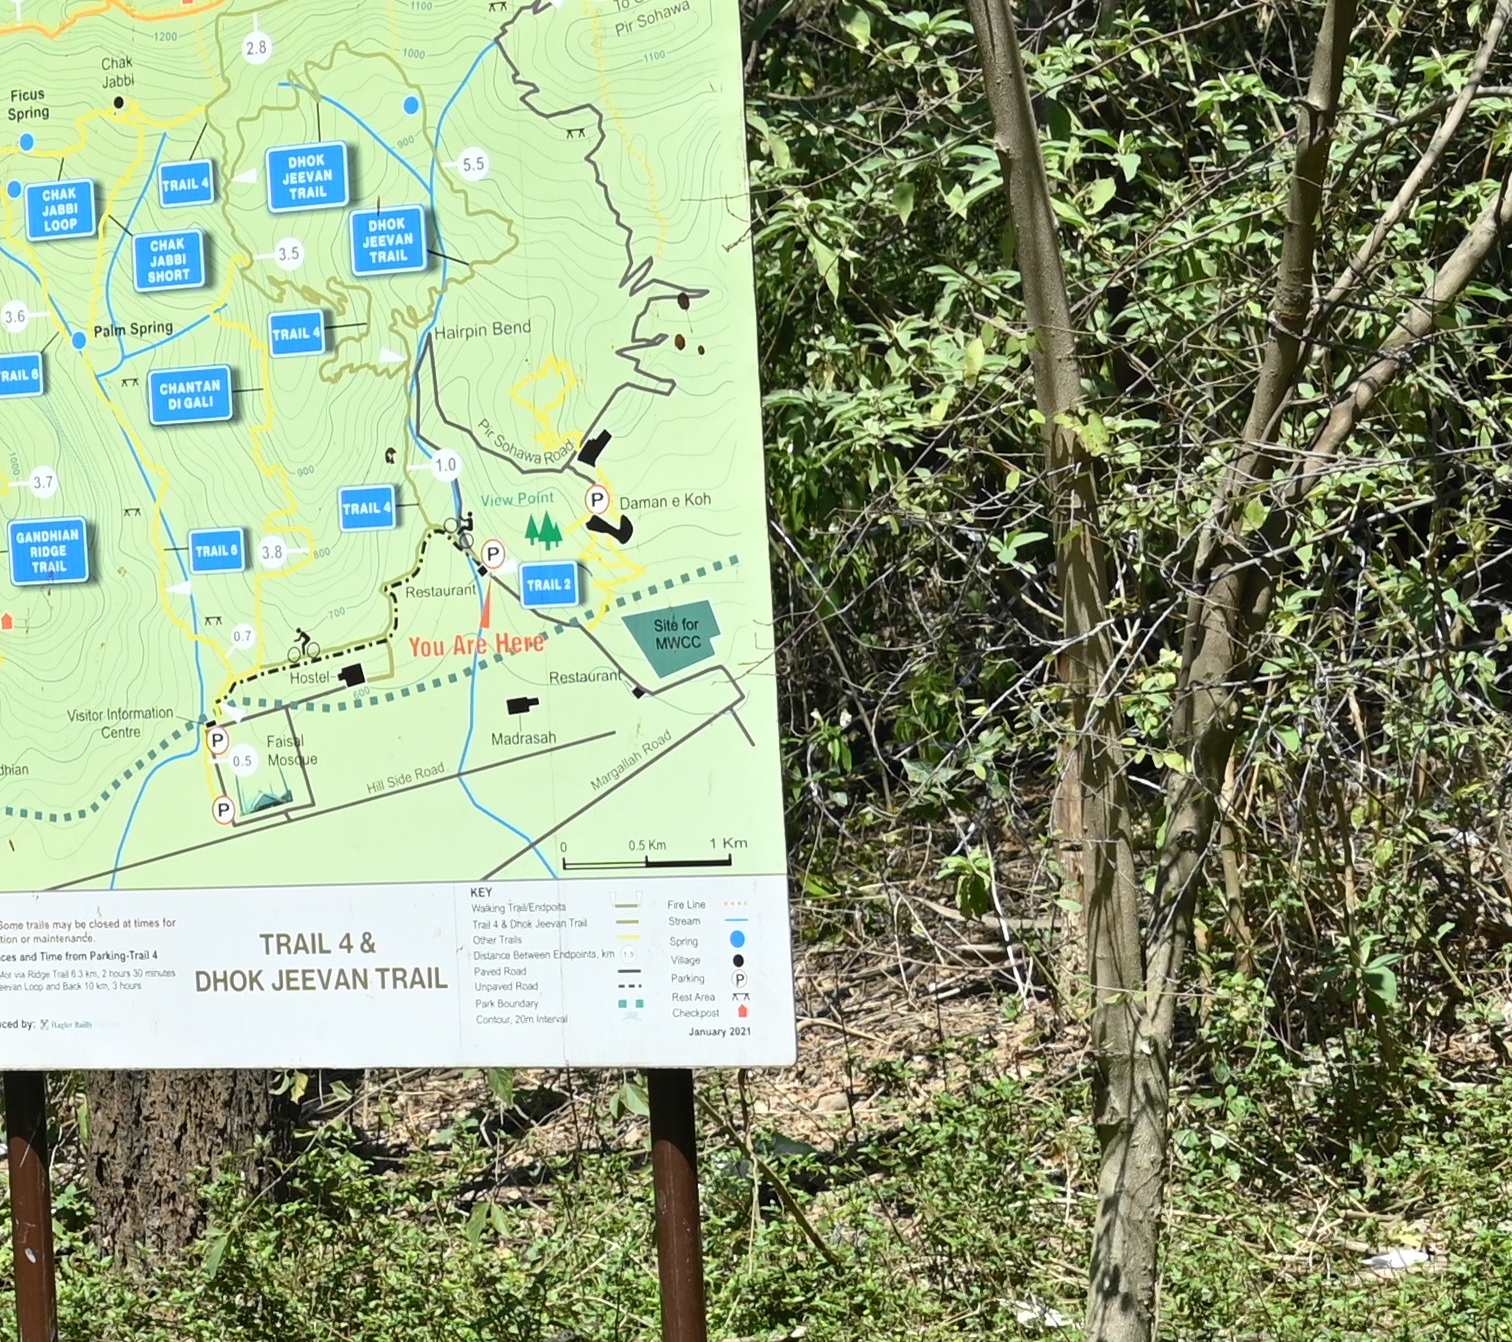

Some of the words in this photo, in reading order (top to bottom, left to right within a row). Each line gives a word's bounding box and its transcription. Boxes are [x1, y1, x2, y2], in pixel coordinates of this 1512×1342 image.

[616, 20, 634, 37] Pir
[637, 0, 690, 26] Sohawa
[247, 41, 267, 55] 2.8
[102, 56, 132, 71] Chak
[102, 72, 134, 89] Jabbi
[11, 89, 45, 102] Ficus
[8, 107, 49, 121] Spring
[288, 154, 324, 169] DHOK
[463, 157, 484, 171] 5.5
[283, 169, 332, 185] JEEVAN
[163, 179, 198, 192] TRAIL
[201, 178, 208, 188] 4
[42, 188, 76, 201] CHAK
[289, 186, 327, 200] TRAIL
[42, 203, 78, 216] JABBI
[44, 218, 77, 232] LOOP
[368, 218, 405, 232] DHOK
[150, 238, 184, 252] CHAK
[363, 233, 413, 248] JEEVAN
[279, 247, 299, 260] 3.5
[370, 250, 407, 264] TRAIL
[150, 254, 186, 268] JABBI
[148, 268, 190, 283] SHORT
[5, 310, 25, 323] 3.6
[95, 324, 126, 337] Palm
[131, 321, 173, 336] Spring
[273, 328, 310, 341] TRAIL
[313, 326, 320, 338] 4
[435, 324, 487, 340] Hairpin
[493, 321, 531, 335] Bend
[31, 368, 38, 380] 6
[160, 380, 220, 396] CHANTAN
[168, 396, 182, 409] DI
[185, 395, 213, 409] GALI
[477, 418, 494, 437] Pir
[493, 433, 541, 464] Sohawa
[544, 440, 574, 464] Road
[436, 457, 456, 472] 1.0
[34, 476, 53, 488] 3.7
[481, 493, 513, 507] View
[517, 492, 554, 505] Point
[591, 493, 604, 506] P
[620, 496, 667, 510] Daman
[672, 496, 680, 506] e
[685, 492, 711, 506] Koh
[343, 503, 381, 516] TRAIL
[384, 502, 391, 514] 4
[16, 529, 79, 544] GANDHIAN
[30, 546, 66, 558] RIDGE
[196, 543, 229, 557] TRAIL
[231, 542, 238, 555] 6
[262, 546, 282, 559] 3.8
[487, 547, 499, 560] P
[32, 560, 67, 574] TRAIL
[406, 583, 476, 598] Restaurant
[527, 579, 561, 592] TRAIL
[564, 578, 571, 589] 2
[654, 618, 678, 632] Site
[681, 618, 699, 631] for
[234, 630, 251, 642] 0.7
[656, 634, 701, 650] MWCC
[409, 635, 444, 657] You
[454, 635, 486, 655] Are
[496, 632, 544, 653] Here
[290, 670, 330, 684] Hostel
[549, 670, 622, 684] Restaurant
[67, 708, 103, 722] Visitor
[107, 707, 173, 721] Information
[101, 725, 141, 739] Centre
[491, 732, 556, 746] Madrasah
[213, 733, 224, 746] P
[267, 735, 304, 748] Faisal
[233, 755, 252, 767] 0.5
[268, 753, 318, 767] Mosque
[591, 748, 642, 791] Margallah
[642, 730, 672, 755] Road
[366, 780, 384, 794] Hill
[387, 773, 412, 788] Side
[414, 761, 445, 780] Road
[218, 803, 229, 816] P
[560, 842, 567, 852] 0
[628, 840, 644, 851] 0.5
[648, 839, 666, 850] Km
[711, 838, 716, 849] 1
[723, 838, 748, 849] Km
[471, 888, 492, 898] KEY
[669, 917, 700, 925] Stream
[260, 933, 331, 955] TRAIL
[339, 933, 353, 953] 4
[360, 932, 376, 954] &
[20, 952, 37, 961] and
[41, 952, 62, 961] Time
[66, 951, 86, 960] from
[152, 951, 158, 960] 4
[196, 969, 264, 992] DHOK
[272, 968, 368, 991] JEEVAN
[376, 967, 448, 989] TRAIL
[672, 974, 705, 984] Parking
